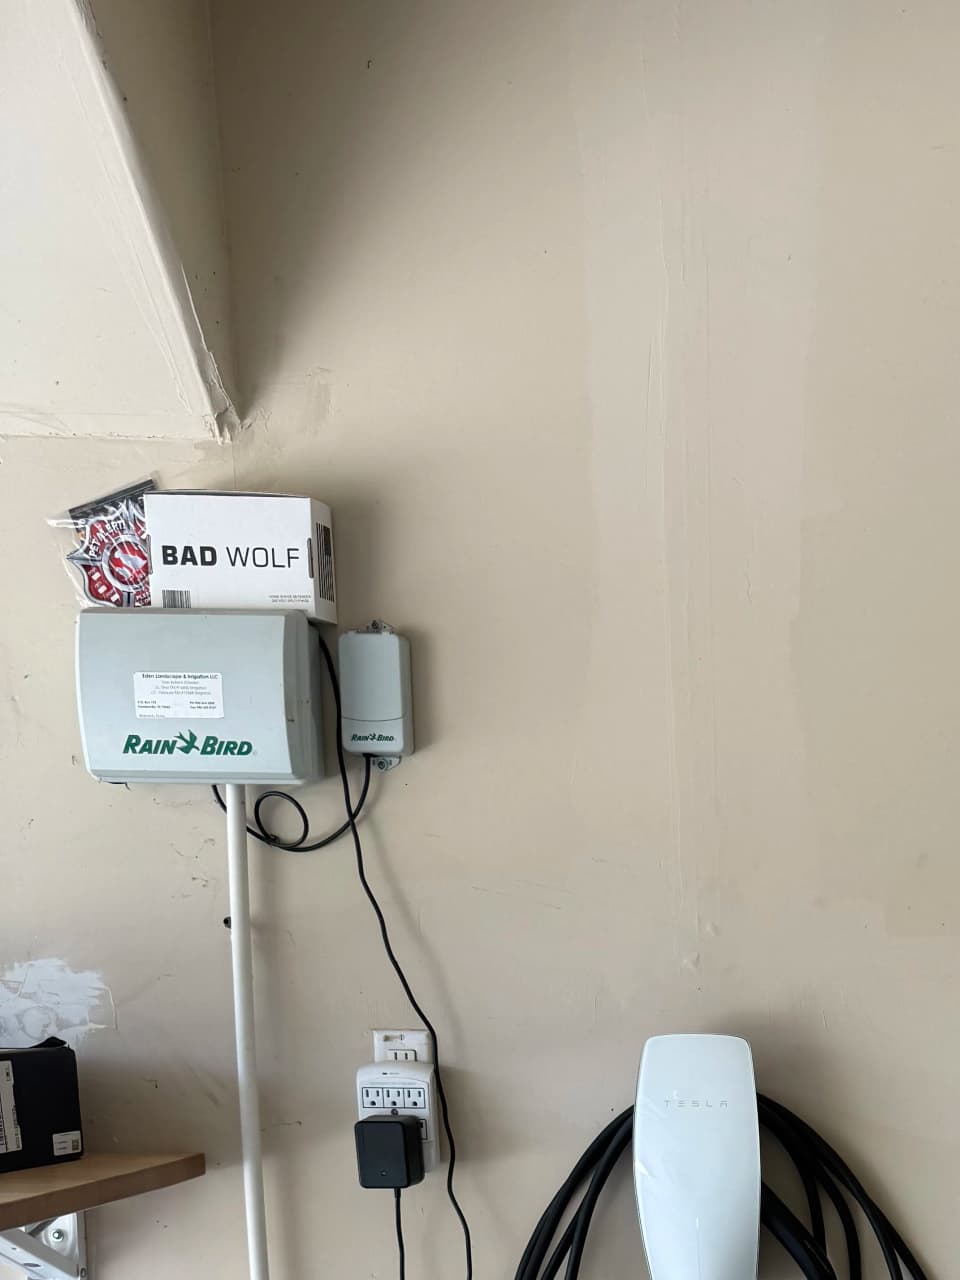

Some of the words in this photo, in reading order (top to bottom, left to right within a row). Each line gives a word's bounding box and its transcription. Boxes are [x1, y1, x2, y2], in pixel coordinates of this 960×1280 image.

[89, 538, 100, 557] PET
[162, 545, 217, 566] BAD
[226, 546, 299, 568] WOLF
[122, 734, 177, 754] RAIN
[200, 735, 253, 756] BIRD
[351, 733, 370, 742] RAIN
[377, 734, 394, 742] BIRD
[663, 1099, 729, 1109] TESLA
